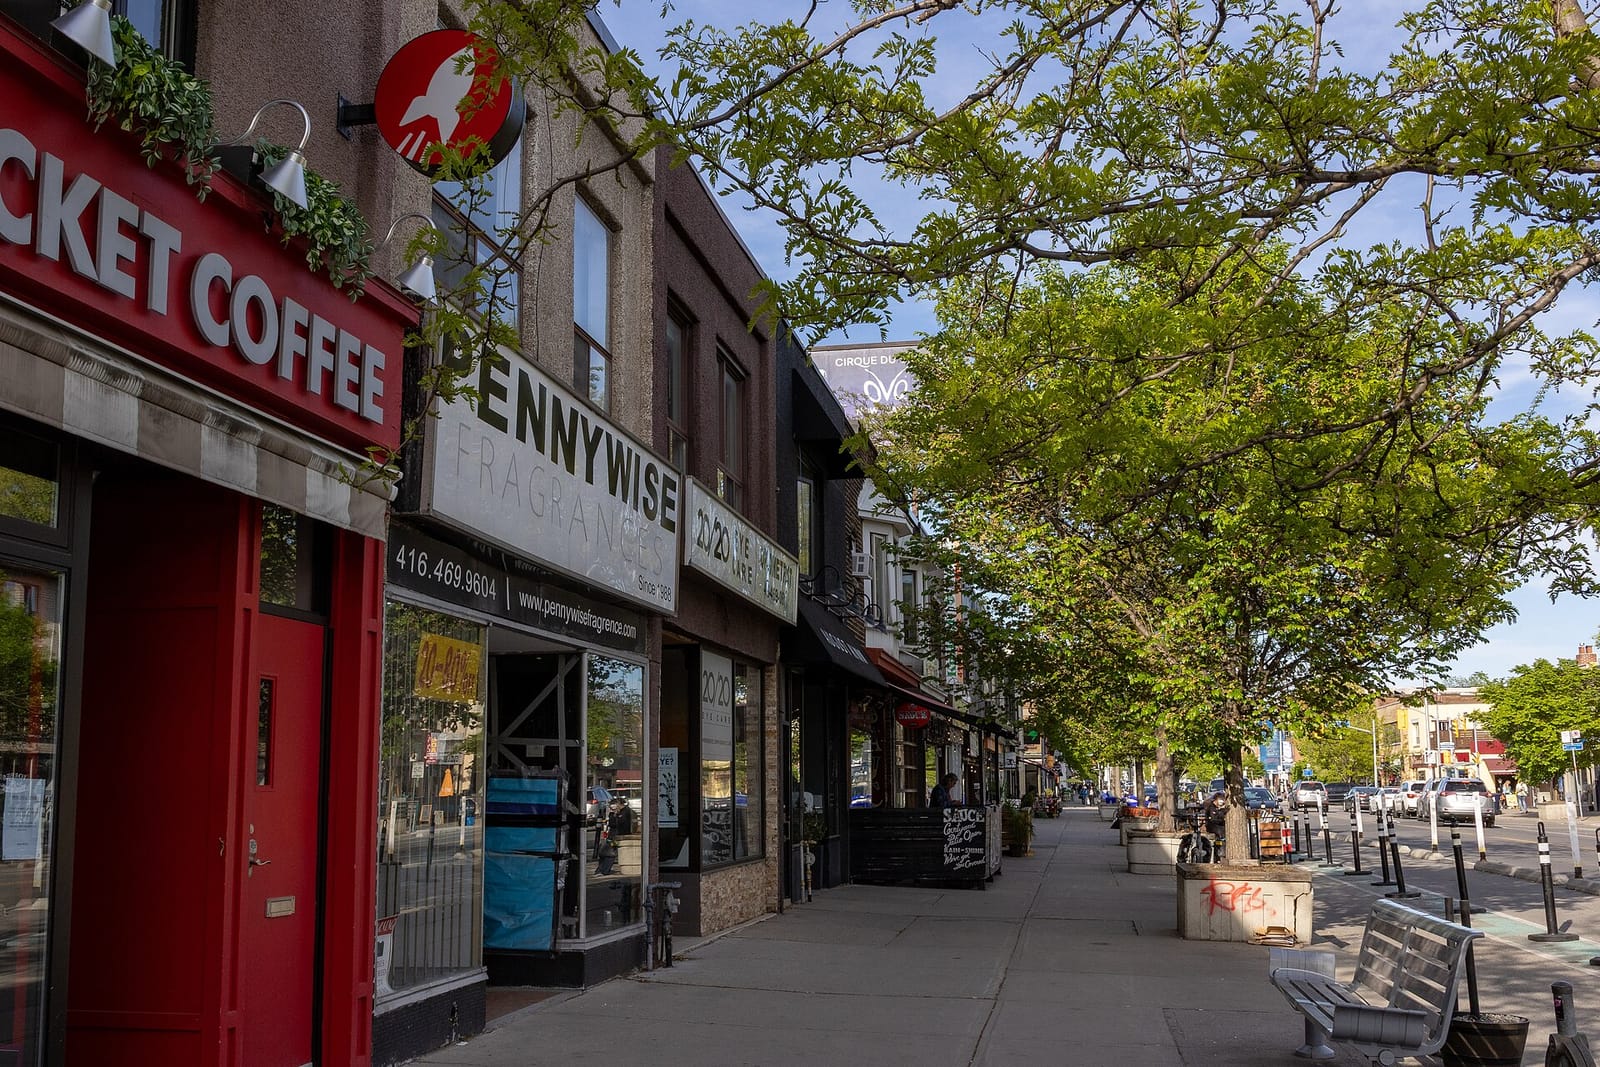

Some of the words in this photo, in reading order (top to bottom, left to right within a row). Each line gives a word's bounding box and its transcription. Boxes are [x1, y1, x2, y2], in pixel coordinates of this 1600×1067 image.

[0, 128, 182, 315] CKET
[190, 253, 386, 425] COFFEE
[835, 356, 877, 368] CIRQUE
[880, 355, 896, 365] DU
[441, 317, 676, 533] PENNYWISE
[457, 422, 663, 576] FRAGRANCES
[697, 508, 730, 563] 20/20
[396, 544, 497, 600] 416.469.9604
[519, 590, 637, 639] www.pennywisefragrence.com
[639, 574, 655, 596] Since
[657, 583, 672, 603] 1988
[702, 670, 731, 707] 20/20
[943, 808, 985, 823] SAUCE
